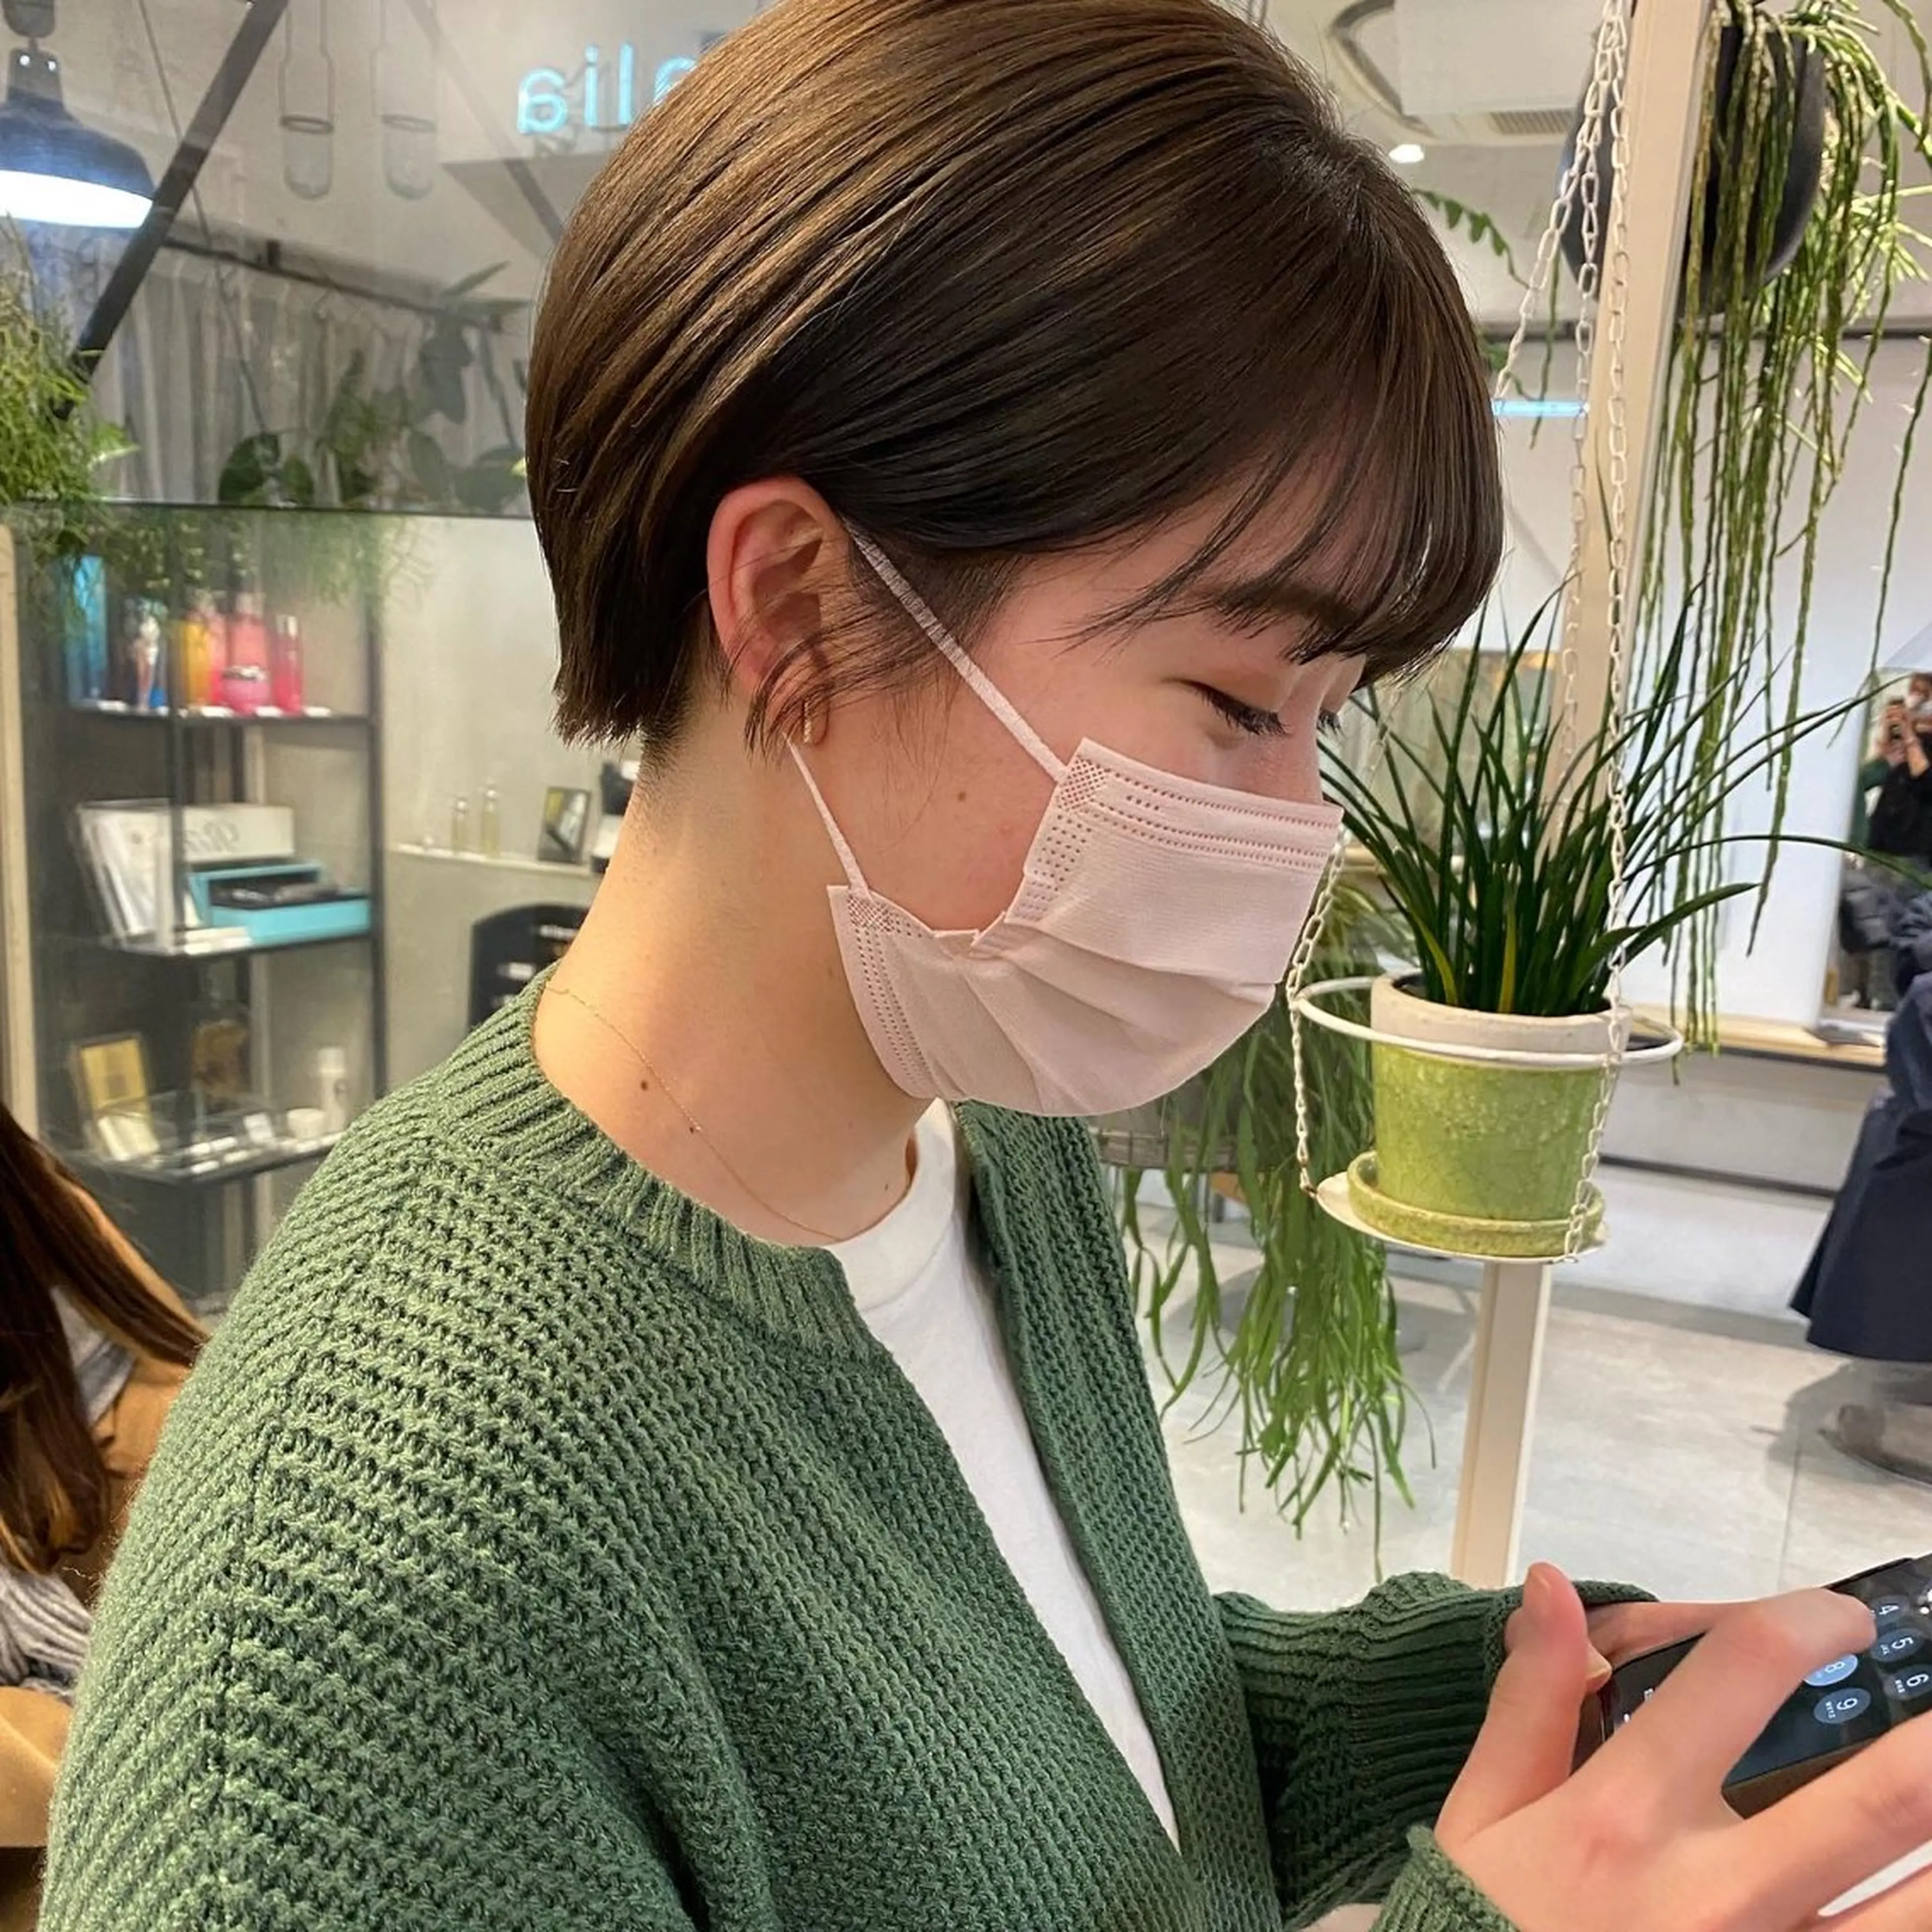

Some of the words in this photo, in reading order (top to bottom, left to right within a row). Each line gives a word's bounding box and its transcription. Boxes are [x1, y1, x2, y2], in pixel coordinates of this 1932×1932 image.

[1879, 1605, 1899, 1615] 4
[1892, 1637, 1913, 1649] 5
[1825, 1661, 1845, 1673] 8
[1906, 1673, 1929, 1687] 6
[1836, 1698, 1858, 1710] 9
